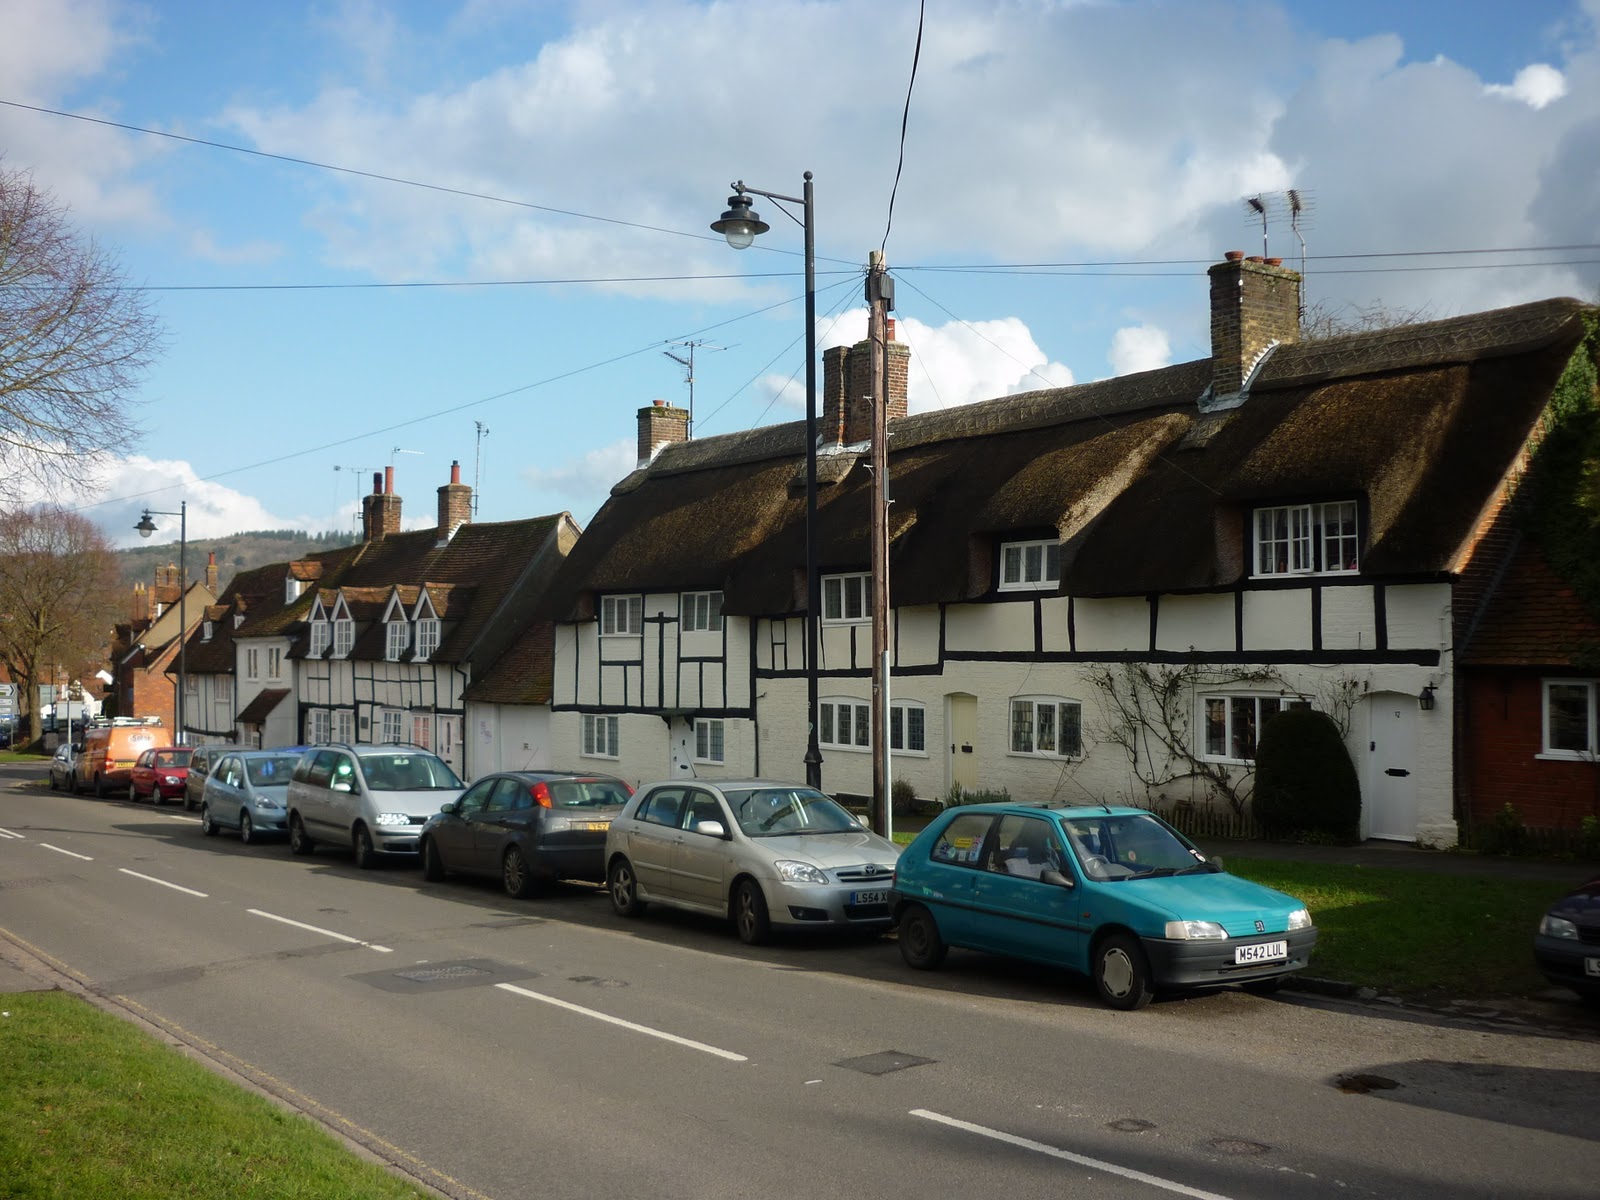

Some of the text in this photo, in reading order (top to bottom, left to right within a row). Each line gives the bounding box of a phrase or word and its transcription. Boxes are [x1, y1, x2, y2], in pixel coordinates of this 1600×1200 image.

[856, 892, 879, 904] LS54
[1240, 943, 1283, 961] M542 LUL
